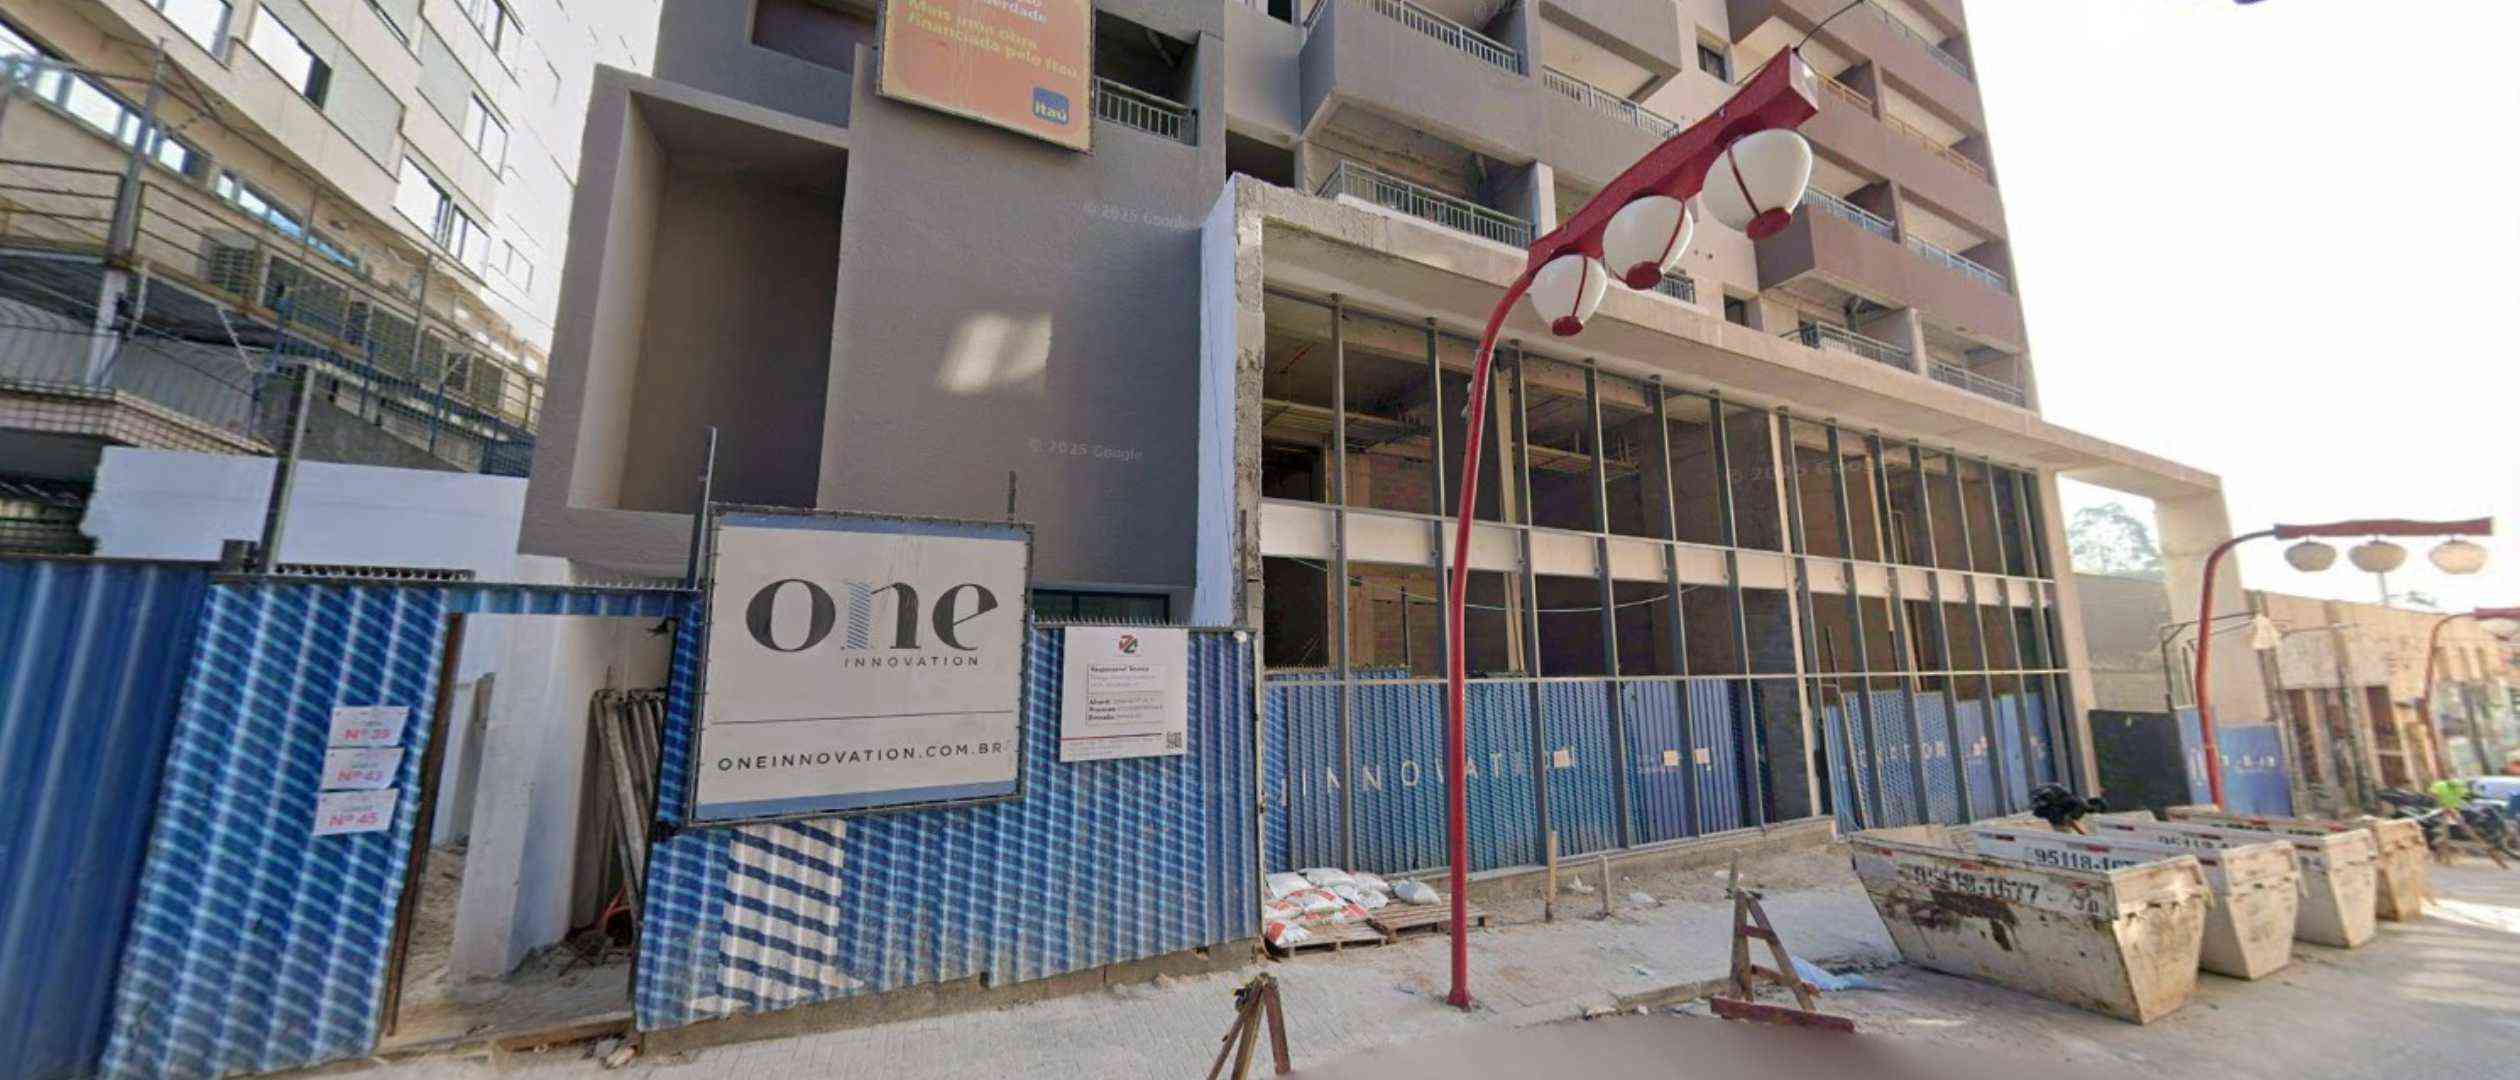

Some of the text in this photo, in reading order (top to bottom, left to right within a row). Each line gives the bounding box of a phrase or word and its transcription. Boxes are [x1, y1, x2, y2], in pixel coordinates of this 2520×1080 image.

[999, 27, 1039, 49] obra
[1005, 44, 1042, 67] pelo
[745, 578, 999, 653] one
[844, 655, 979, 669] INNOVATION
[717, 742, 1003, 773] ONEINNOVATION.COM.BR
